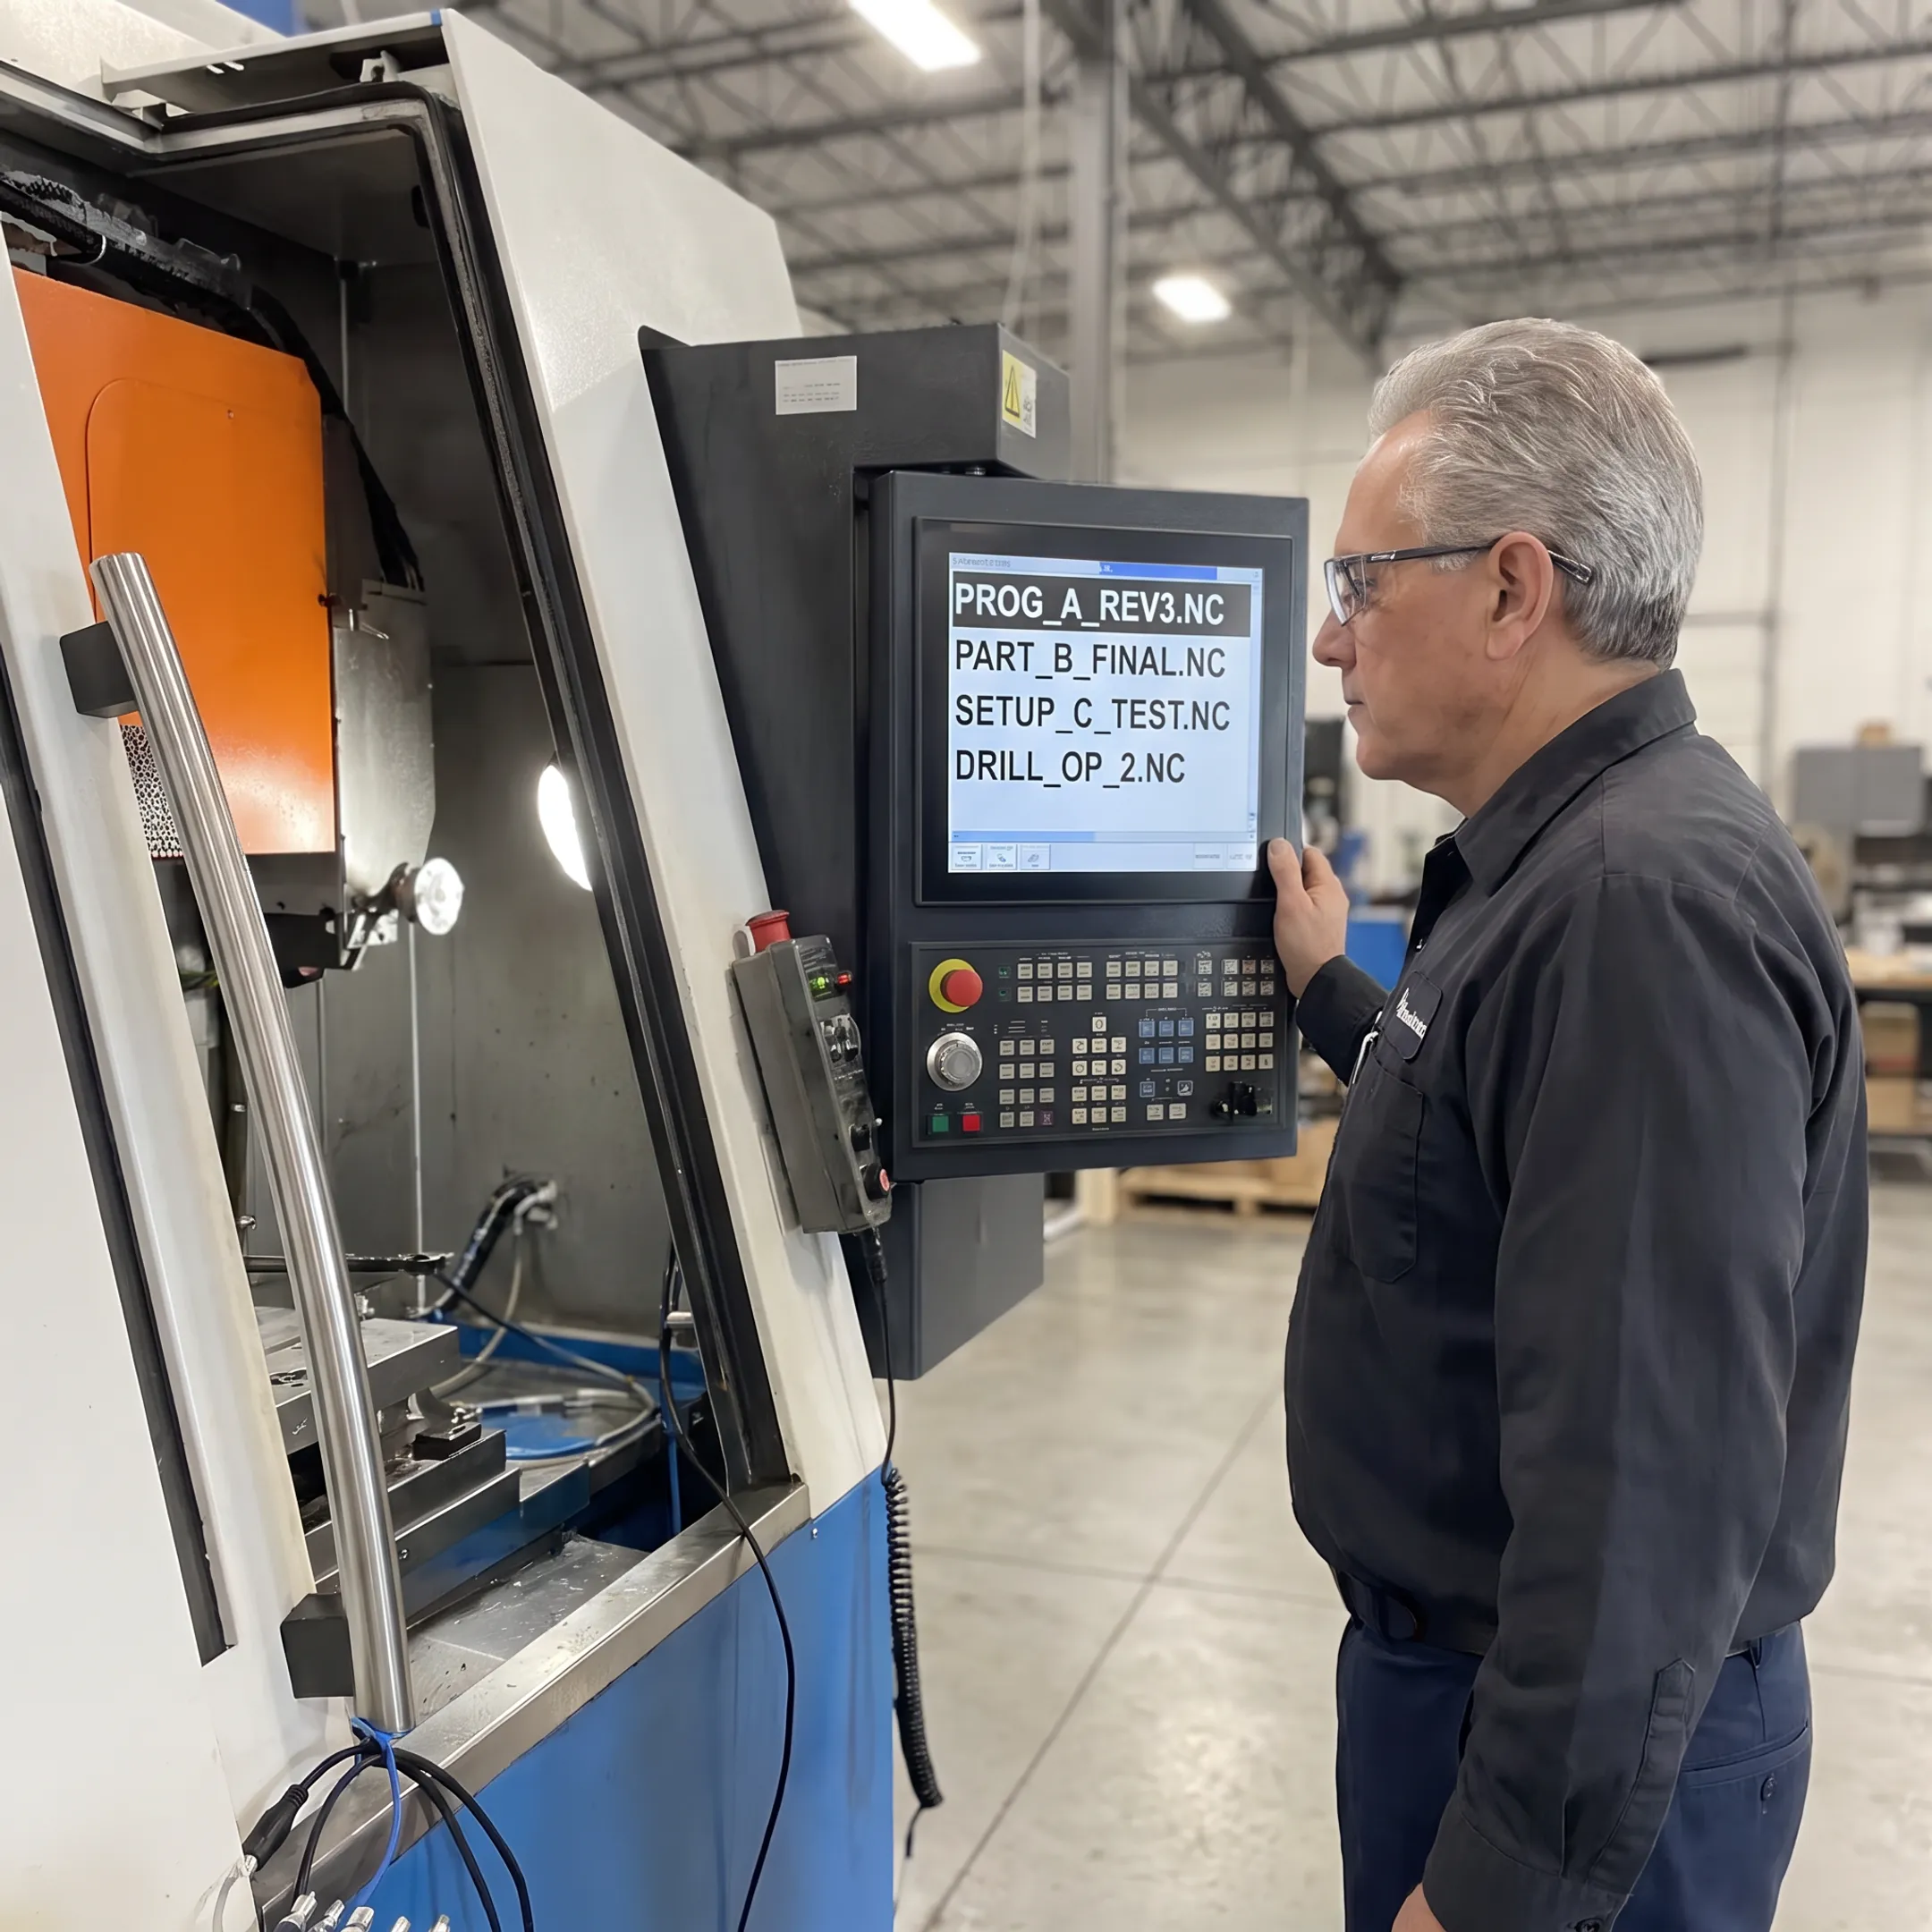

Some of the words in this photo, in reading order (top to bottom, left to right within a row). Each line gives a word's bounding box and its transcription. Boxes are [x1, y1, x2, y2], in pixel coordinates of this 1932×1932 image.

[955, 582, 1224, 627] PROG_A_REV3.NC
[955, 640, 1225, 681] PART_B_FINAL.NC
[955, 694, 1231, 734] SETUP_C_TEST.NC
[955, 750, 1186, 788] DRILL_OP_2.NC
